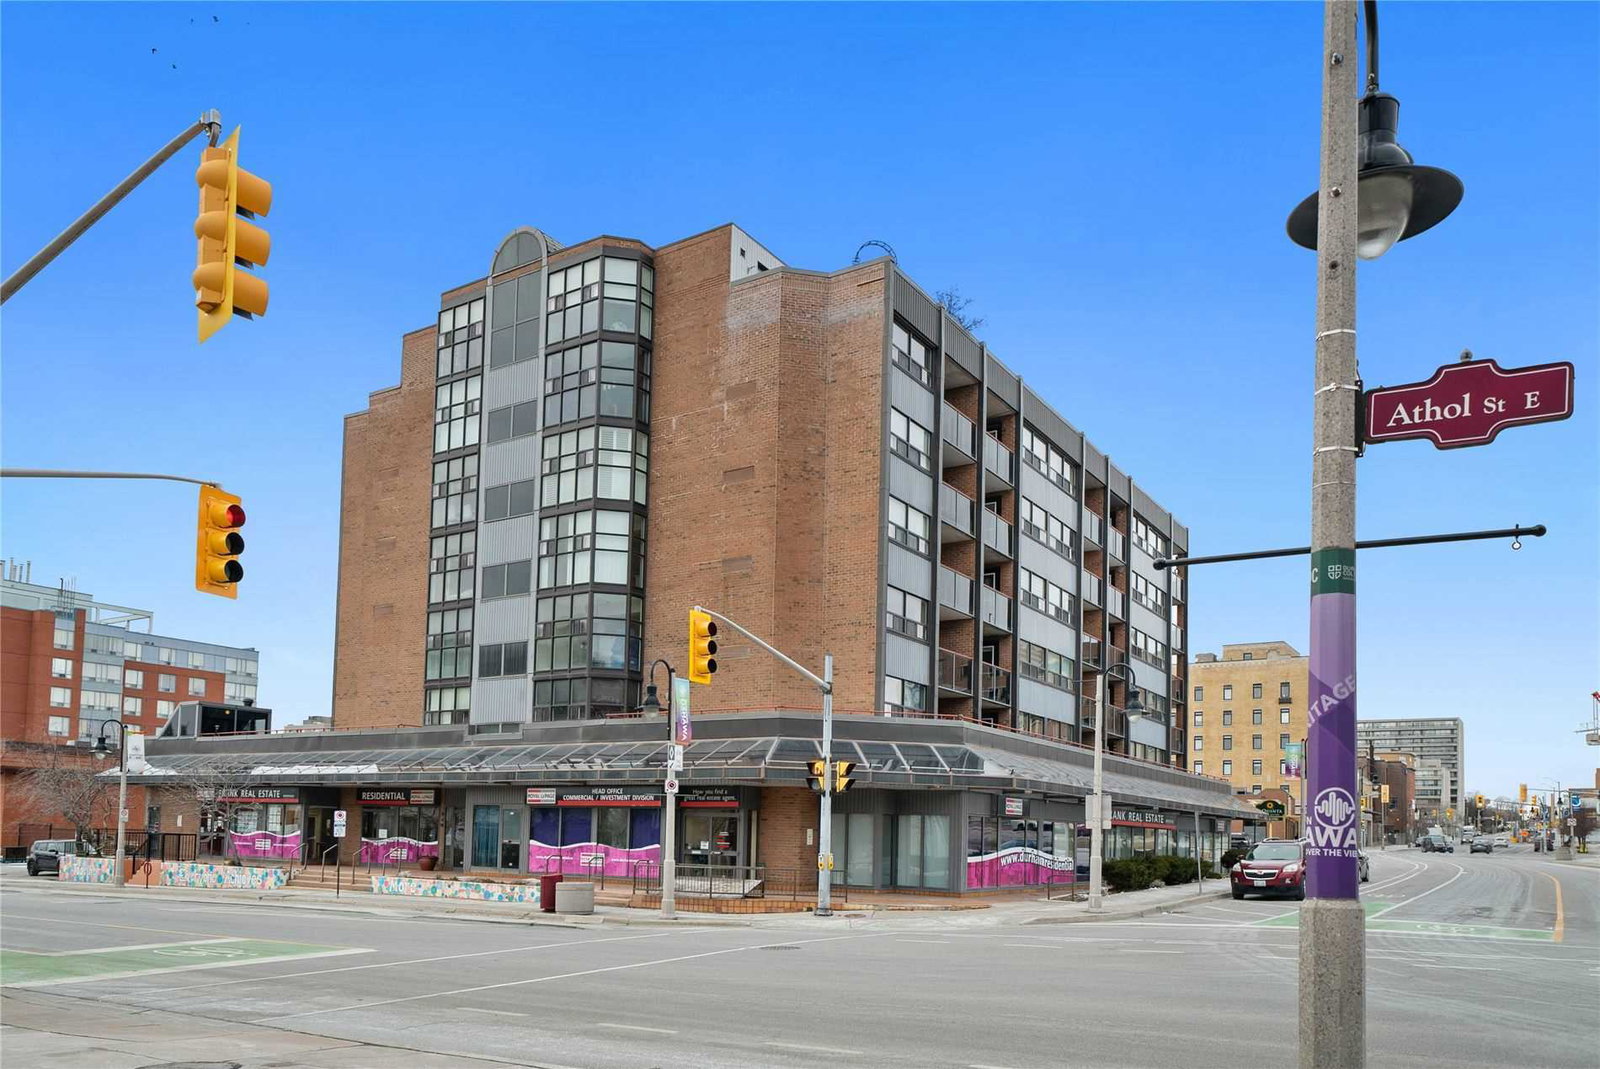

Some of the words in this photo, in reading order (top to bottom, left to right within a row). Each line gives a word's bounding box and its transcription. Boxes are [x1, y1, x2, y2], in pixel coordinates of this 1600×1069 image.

[1386, 393, 1472, 427] Athol
[1483, 397, 1506, 414] St
[1524, 391, 1541, 410] E
[240, 790, 256, 798] REAL
[258, 790, 280, 798] ESTATE
[361, 791, 405, 800] RESIDENTIAL
[1128, 812, 1143, 823] REAL
[1145, 813, 1164, 824] ESTATE
[1323, 849, 1342, 857] THE
